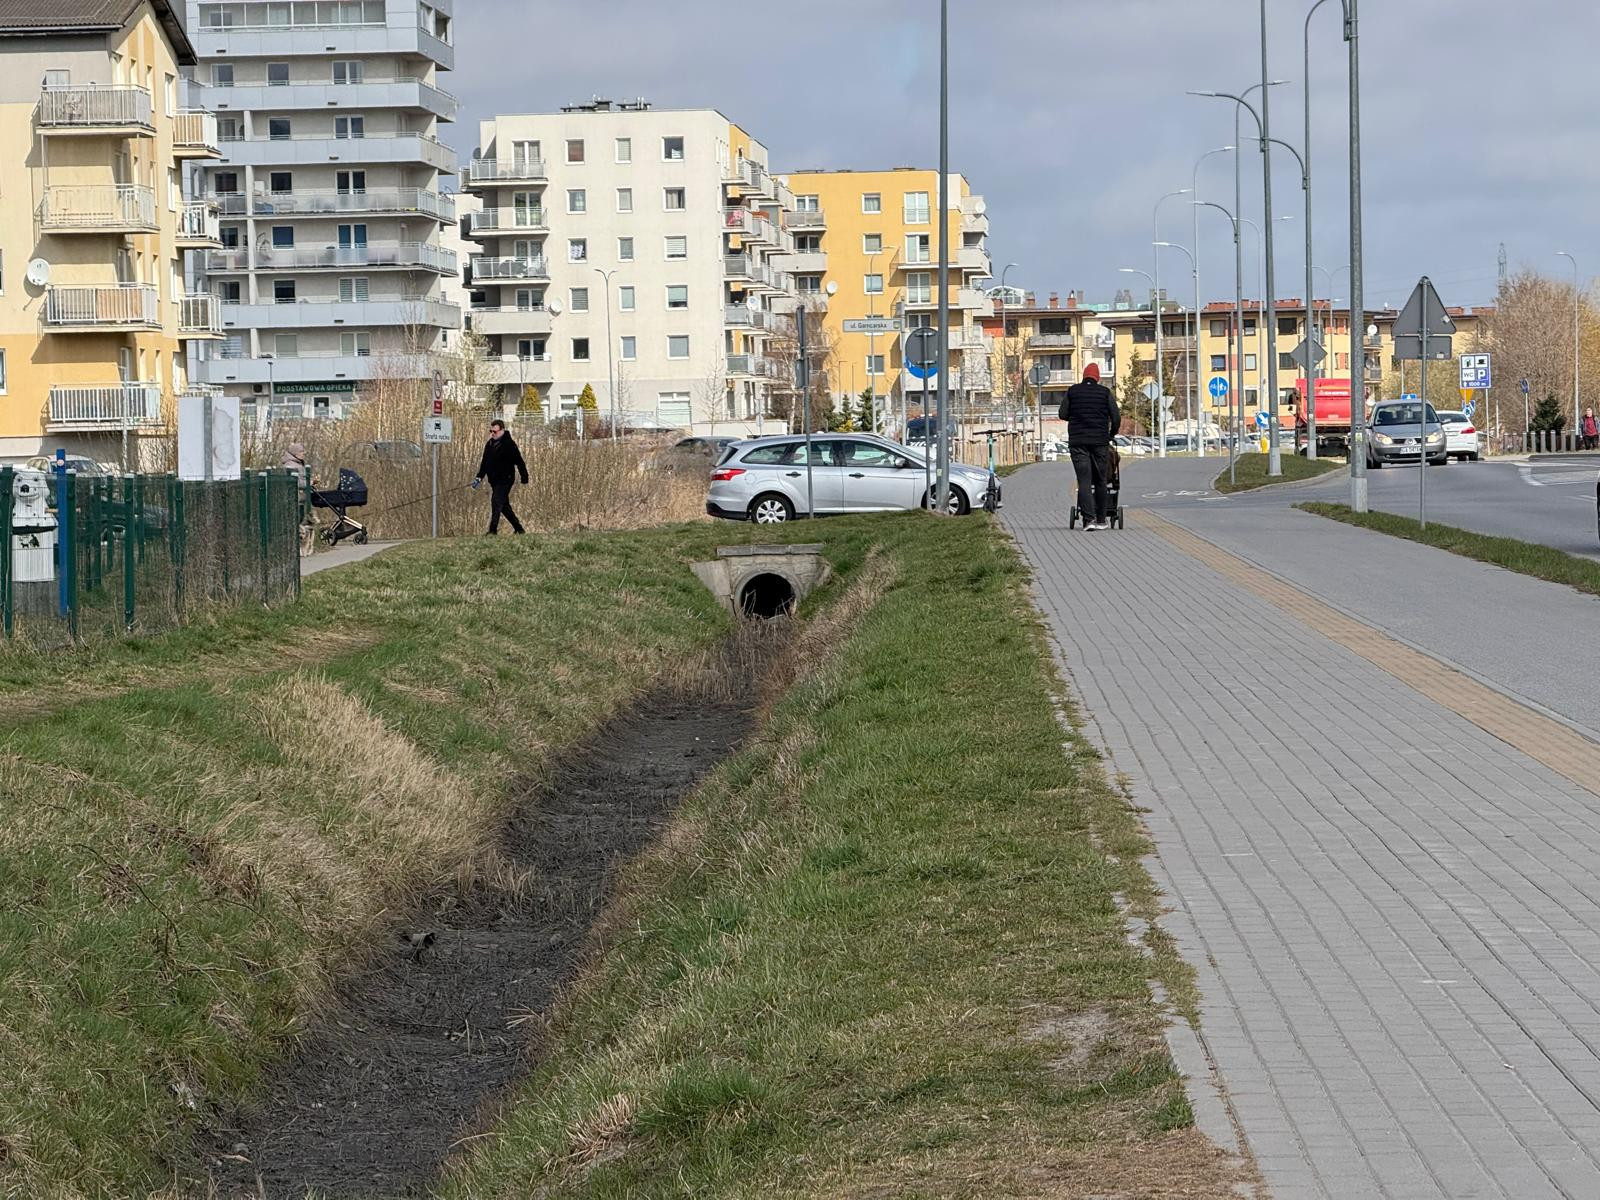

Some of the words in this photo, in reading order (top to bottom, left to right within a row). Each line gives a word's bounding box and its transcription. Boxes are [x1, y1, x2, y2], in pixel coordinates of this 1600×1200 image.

[1477, 369, 1486, 380] P
[277, 384, 326, 392] PODSTAWOWA
[326, 383, 351, 391] OPIEKA
